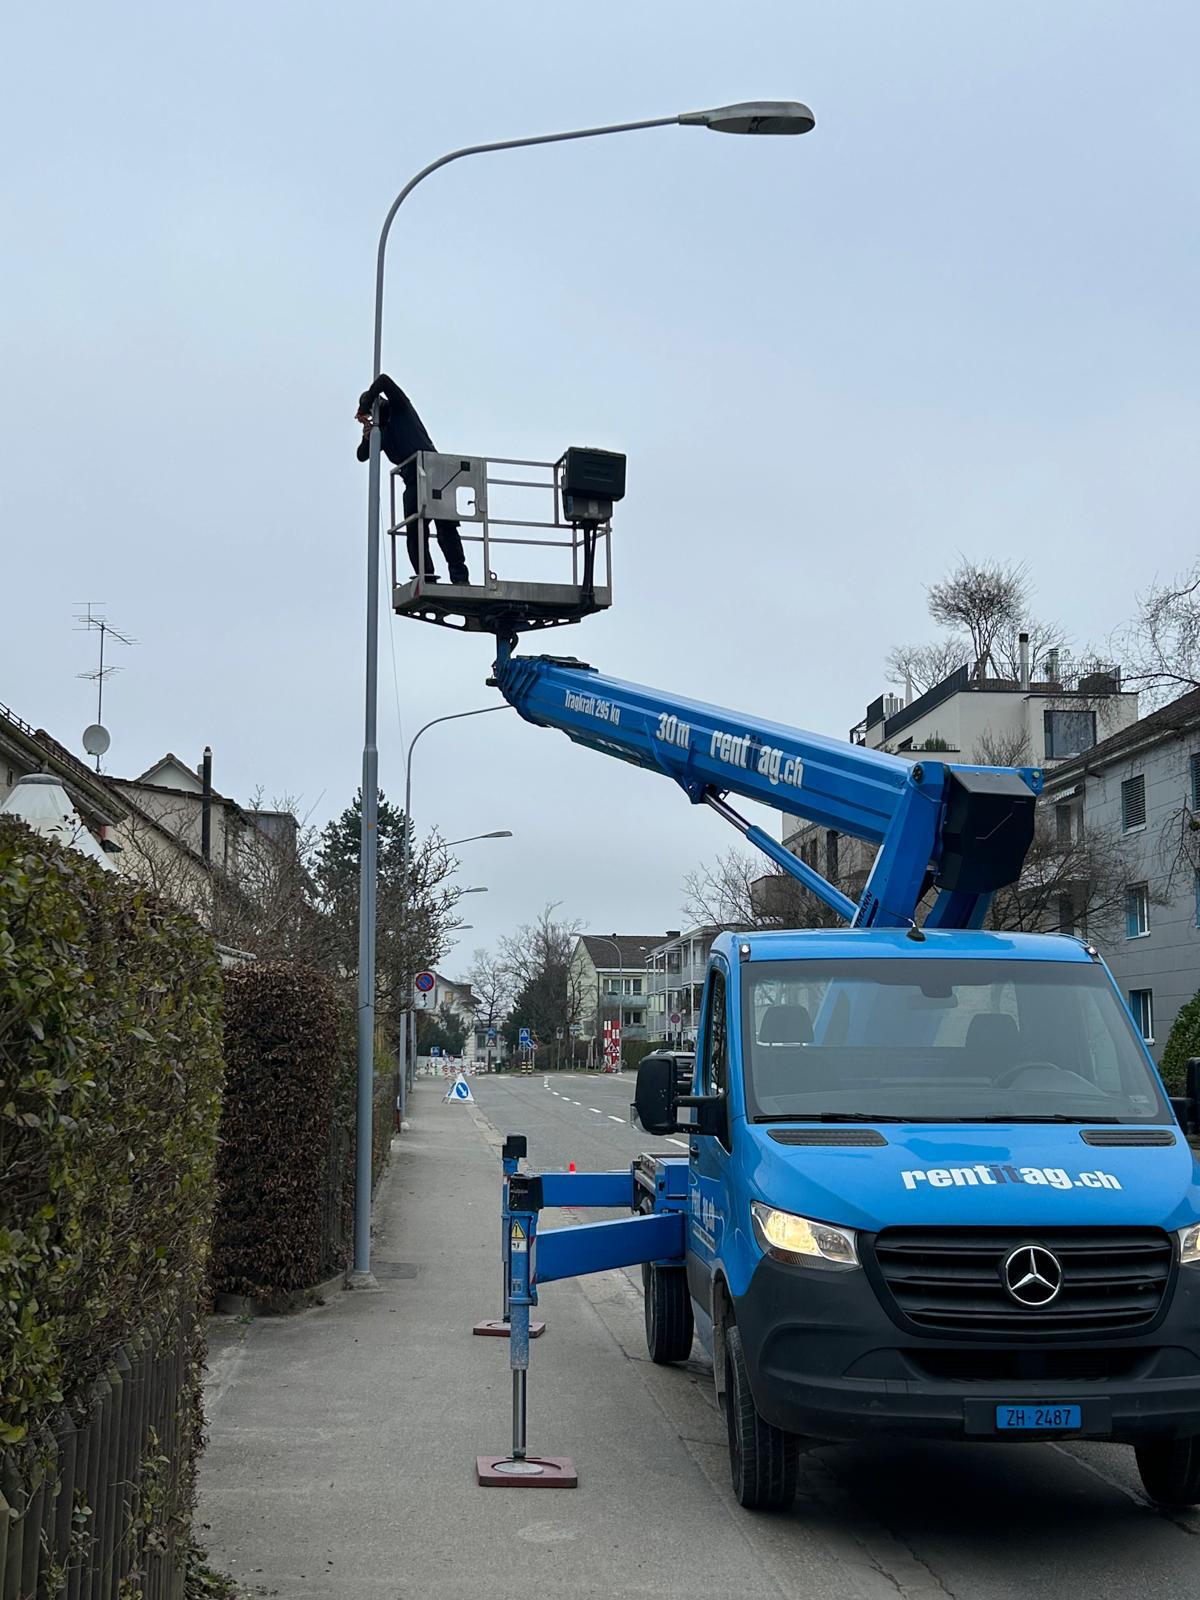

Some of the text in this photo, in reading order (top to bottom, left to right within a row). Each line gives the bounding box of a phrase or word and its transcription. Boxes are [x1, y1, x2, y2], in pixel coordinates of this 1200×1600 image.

[564, 689, 621, 726] Tragkraft 295 kg
[901, 1164, 1123, 1190] rentitag.ch
